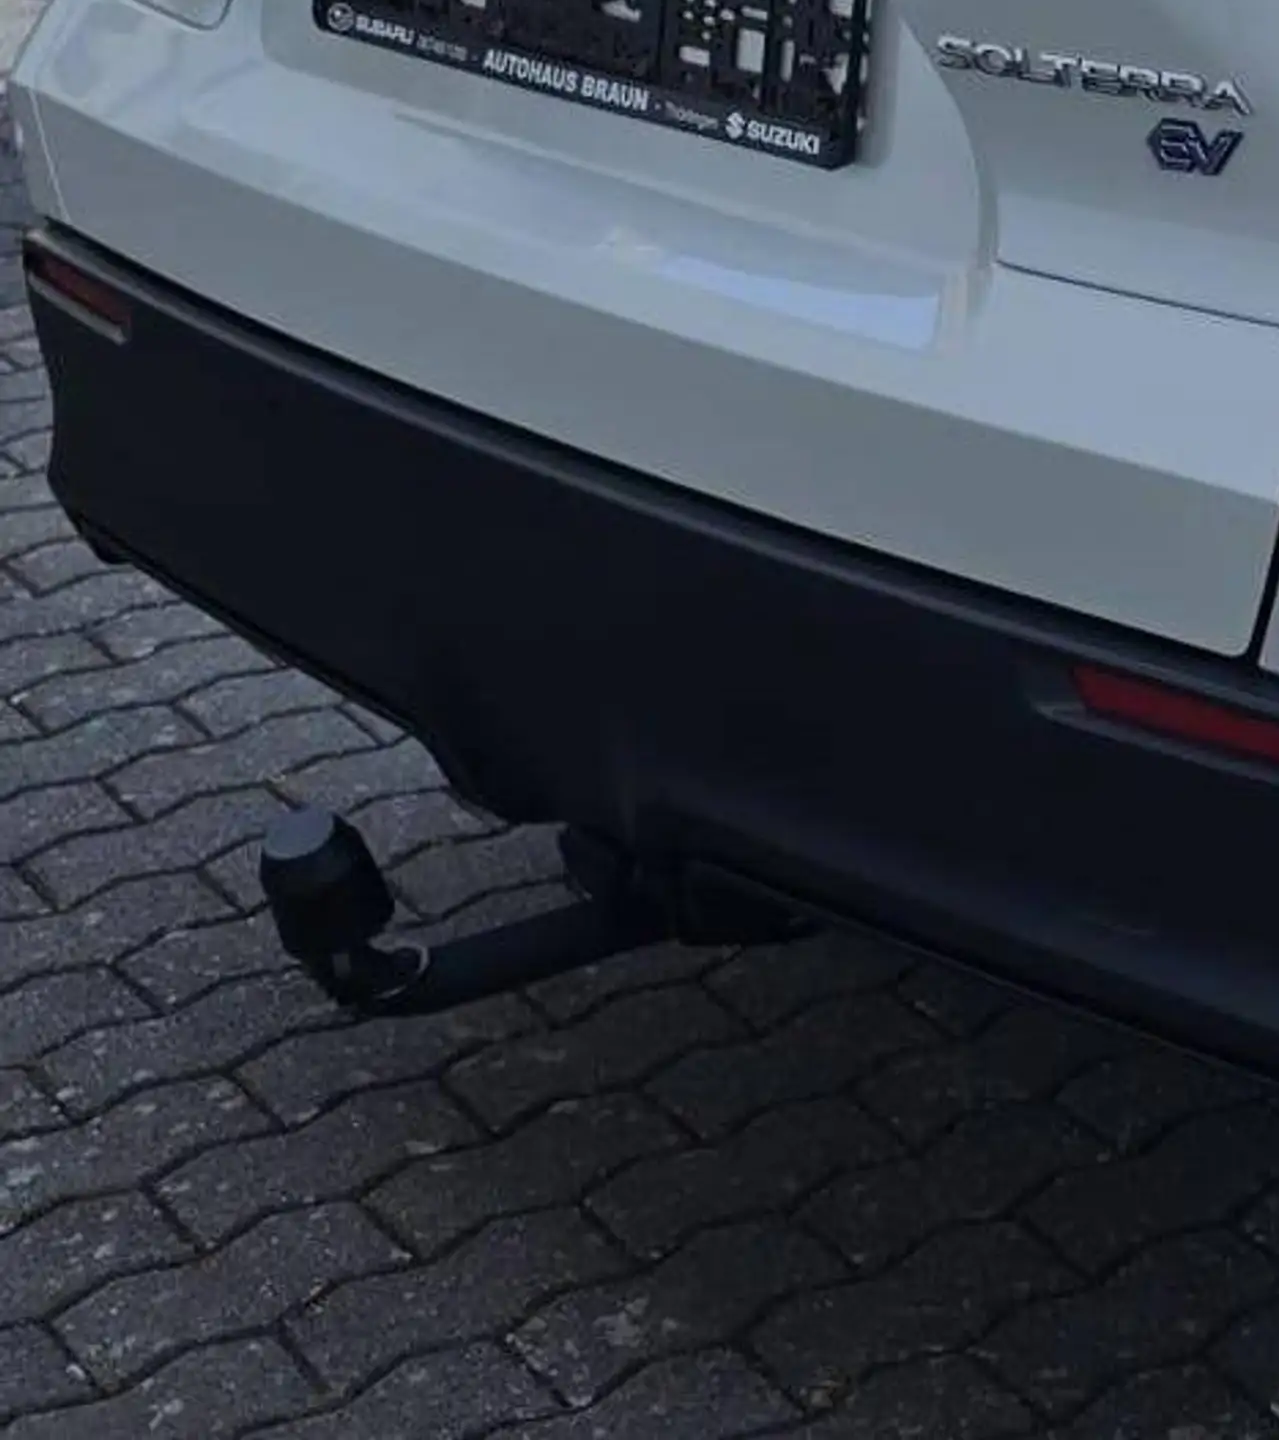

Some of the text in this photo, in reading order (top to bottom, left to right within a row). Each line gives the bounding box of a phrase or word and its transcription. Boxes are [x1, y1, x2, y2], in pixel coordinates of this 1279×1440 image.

[483, 49, 579, 92] AUTOHAUS
[580, 75, 651, 110] BRAUN
[747, 120, 820, 155] SUZUKI
[936, 35, 1252, 116] SOLTERRA
[1146, 117, 1244, 176] EV
